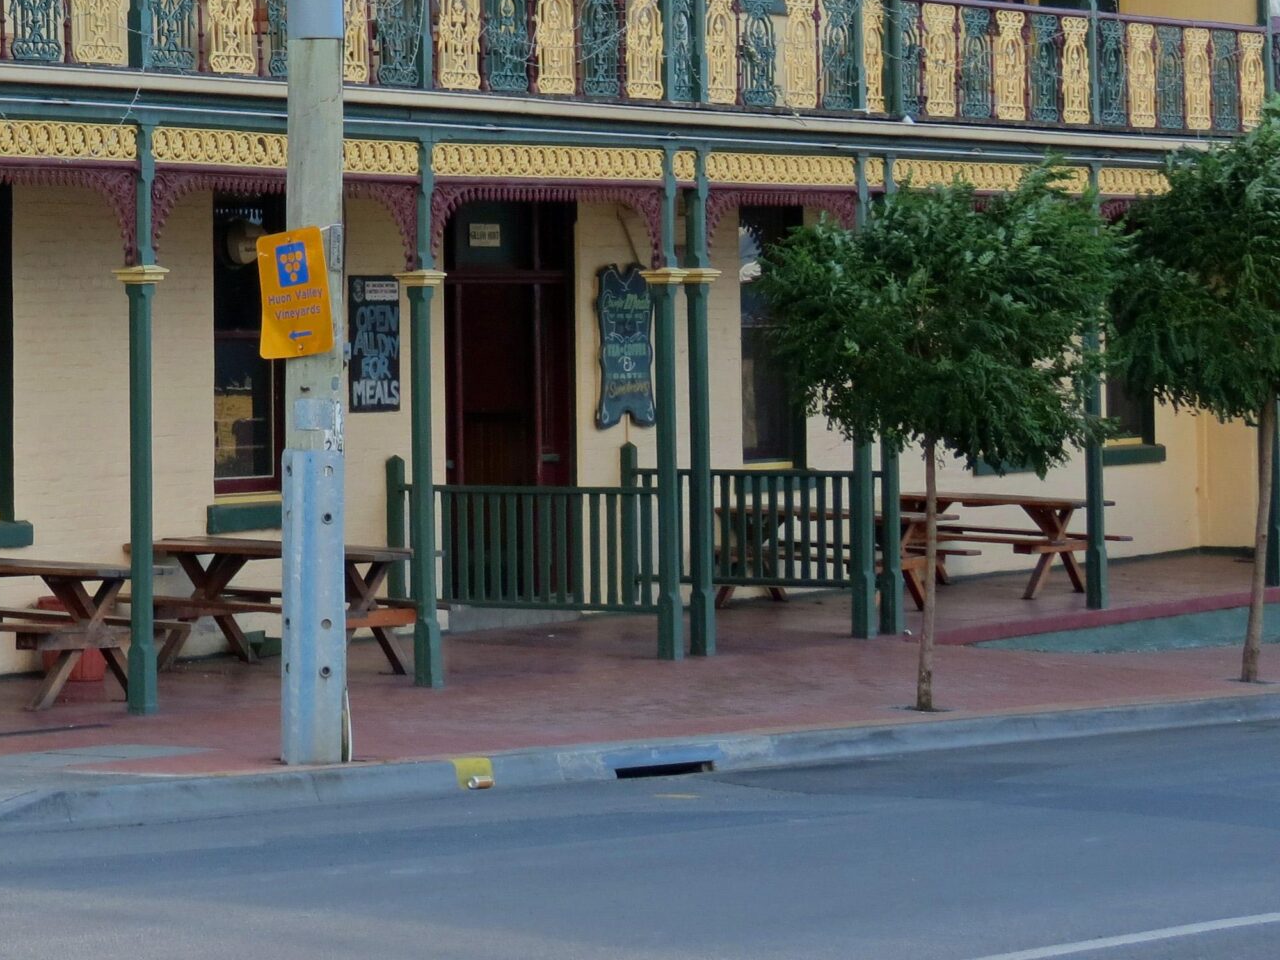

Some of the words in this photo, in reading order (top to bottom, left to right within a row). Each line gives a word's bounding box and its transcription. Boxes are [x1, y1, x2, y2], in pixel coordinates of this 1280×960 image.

[268, 293, 292, 306] Huon
[295, 287, 323, 300] Valley
[275, 304, 321, 320] Vineyards
[356, 304, 399, 332] OPEN
[361, 355, 392, 381] FOR
[352, 378, 400, 407] MEALS
